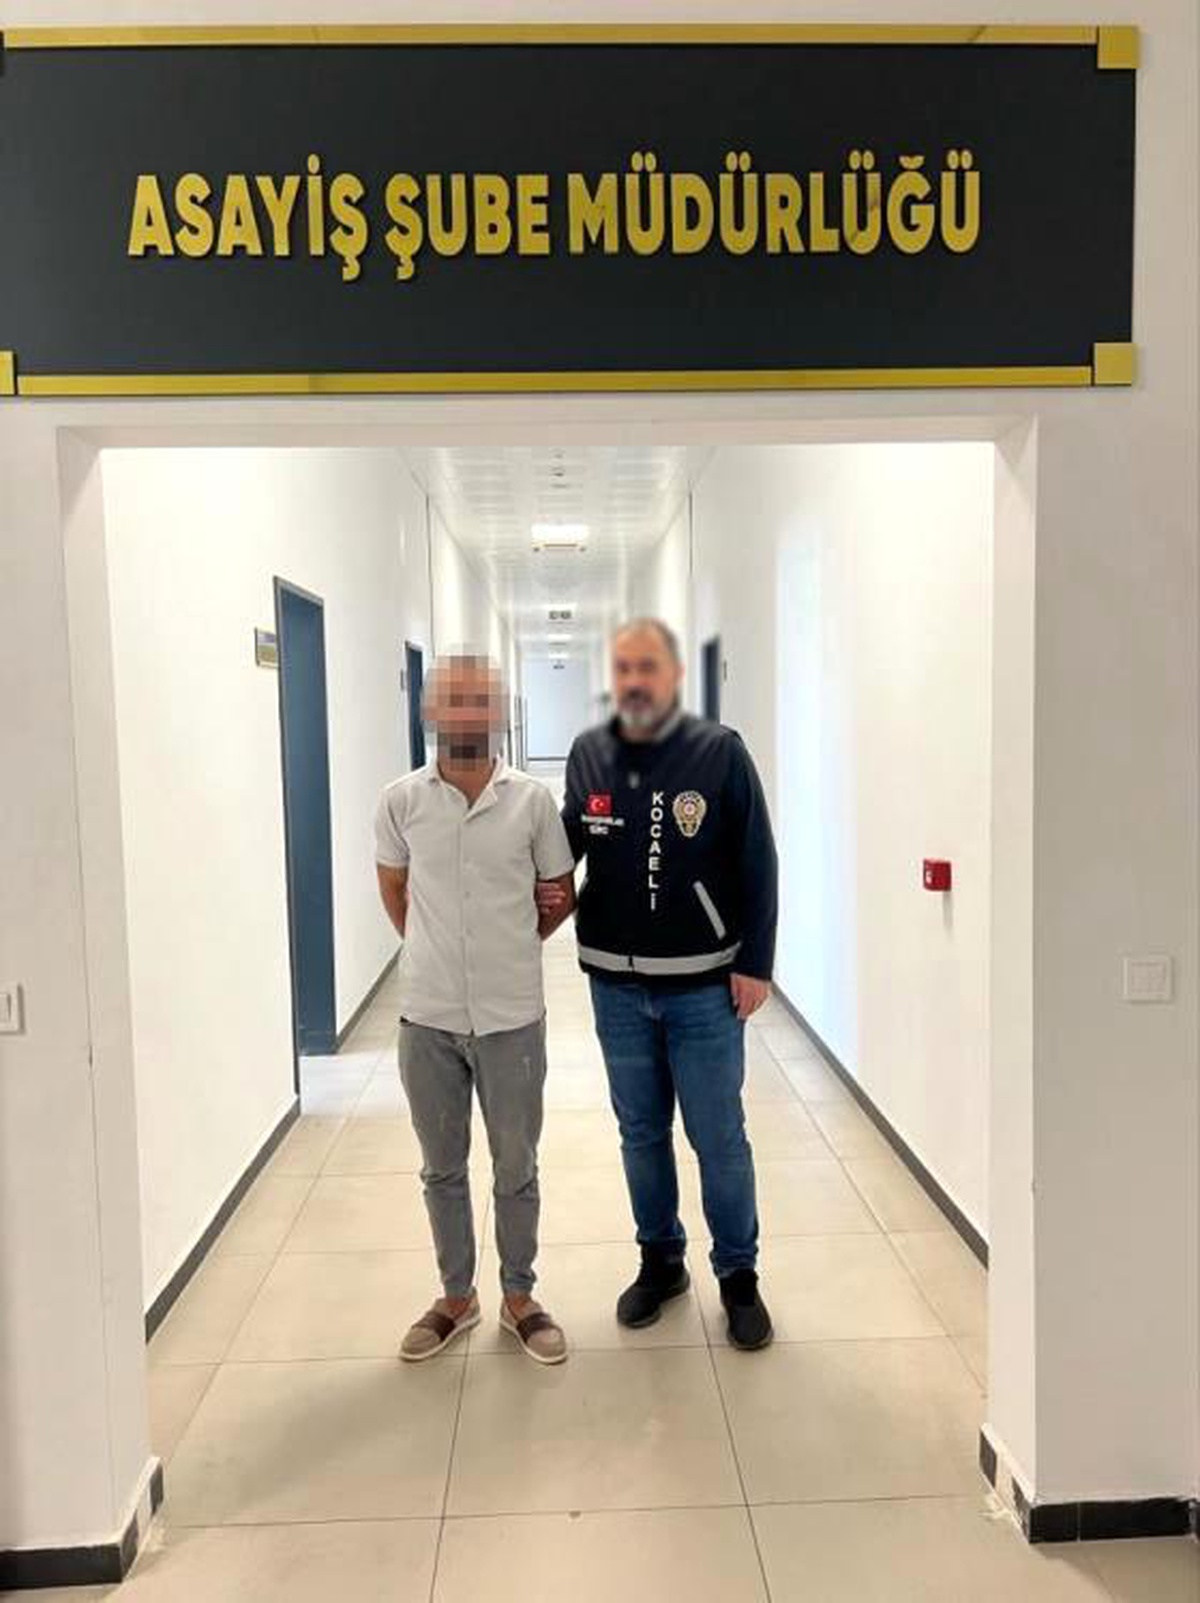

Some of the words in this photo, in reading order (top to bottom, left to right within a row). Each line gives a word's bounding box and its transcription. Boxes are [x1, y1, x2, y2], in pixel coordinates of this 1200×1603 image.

[128, 153, 368, 281] ASAYİŞ
[384, 173, 551, 280] ŞUBE
[568, 151, 981, 254] MÜDÜRLÜĞÜ
